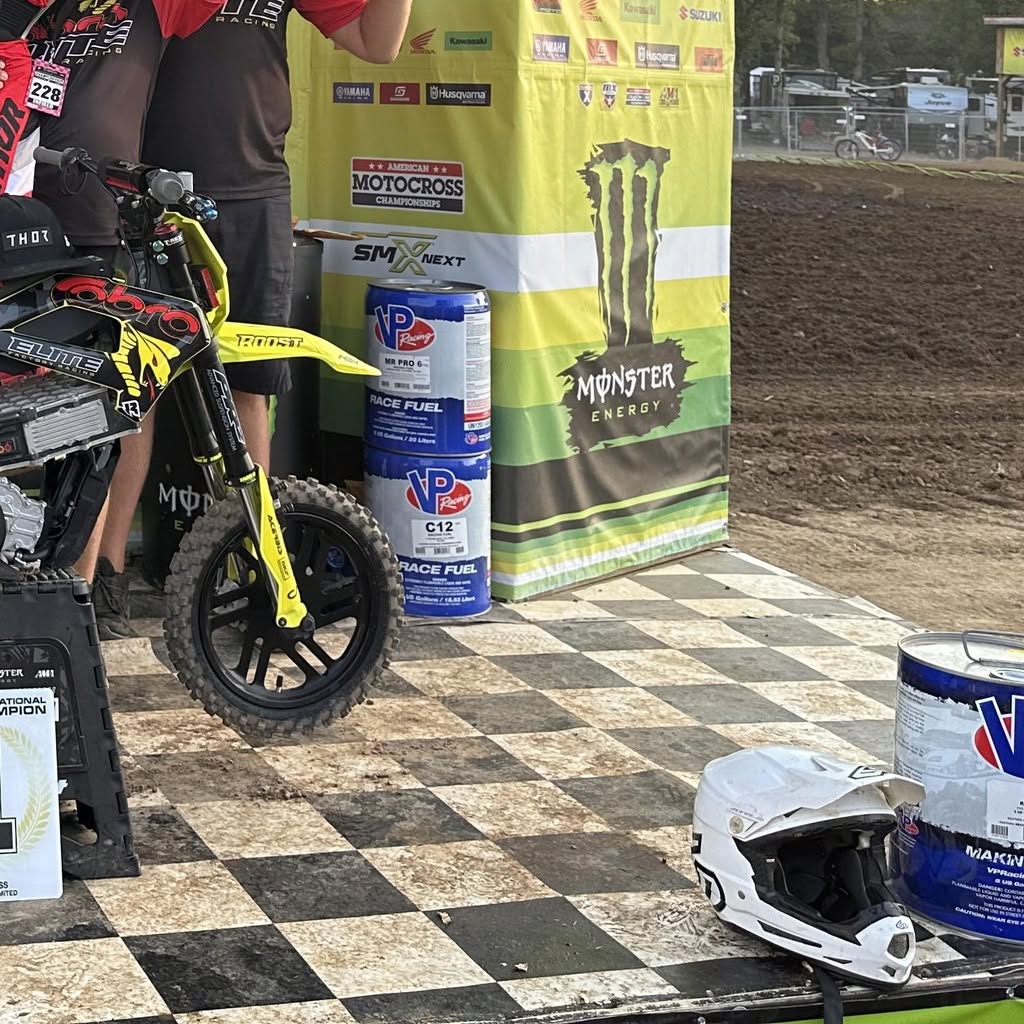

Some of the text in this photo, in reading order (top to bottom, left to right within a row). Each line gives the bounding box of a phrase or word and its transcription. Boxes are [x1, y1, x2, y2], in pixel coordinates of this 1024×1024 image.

[215, 15, 276, 30] RACING
[690, 10, 722, 23] SUZUKI
[449, 36, 488, 47] Kawasaki
[32, 81, 62, 103] 228
[343, 87, 371, 98] YAMAHA
[439, 88, 486, 100] Husqvarna
[387, 163, 430, 173] AMERICAN
[352, 173, 464, 197] MOTOCROSS
[376, 195, 441, 209] CHAMPIONSHIPS
[6, 230, 50, 247] THOR
[421, 253, 466, 268] NEXT
[374, 303, 416, 352] VP
[399, 331, 436, 347] Racing
[7, 334, 104, 374] ELITE
[384, 357, 397, 366] MR
[397, 358, 415, 368] PRO
[576, 362, 676, 405] MONSTER
[369, 394, 444, 413] RACE FUEL
[591, 399, 661, 423] ENERGY
[406, 467, 458, 516] VP
[439, 493, 472, 512] Racing
[425, 521, 454, 533] C12
[398, 561, 478, 576] RACE FUEL
[965, 844, 1024, 868] MAKIN
